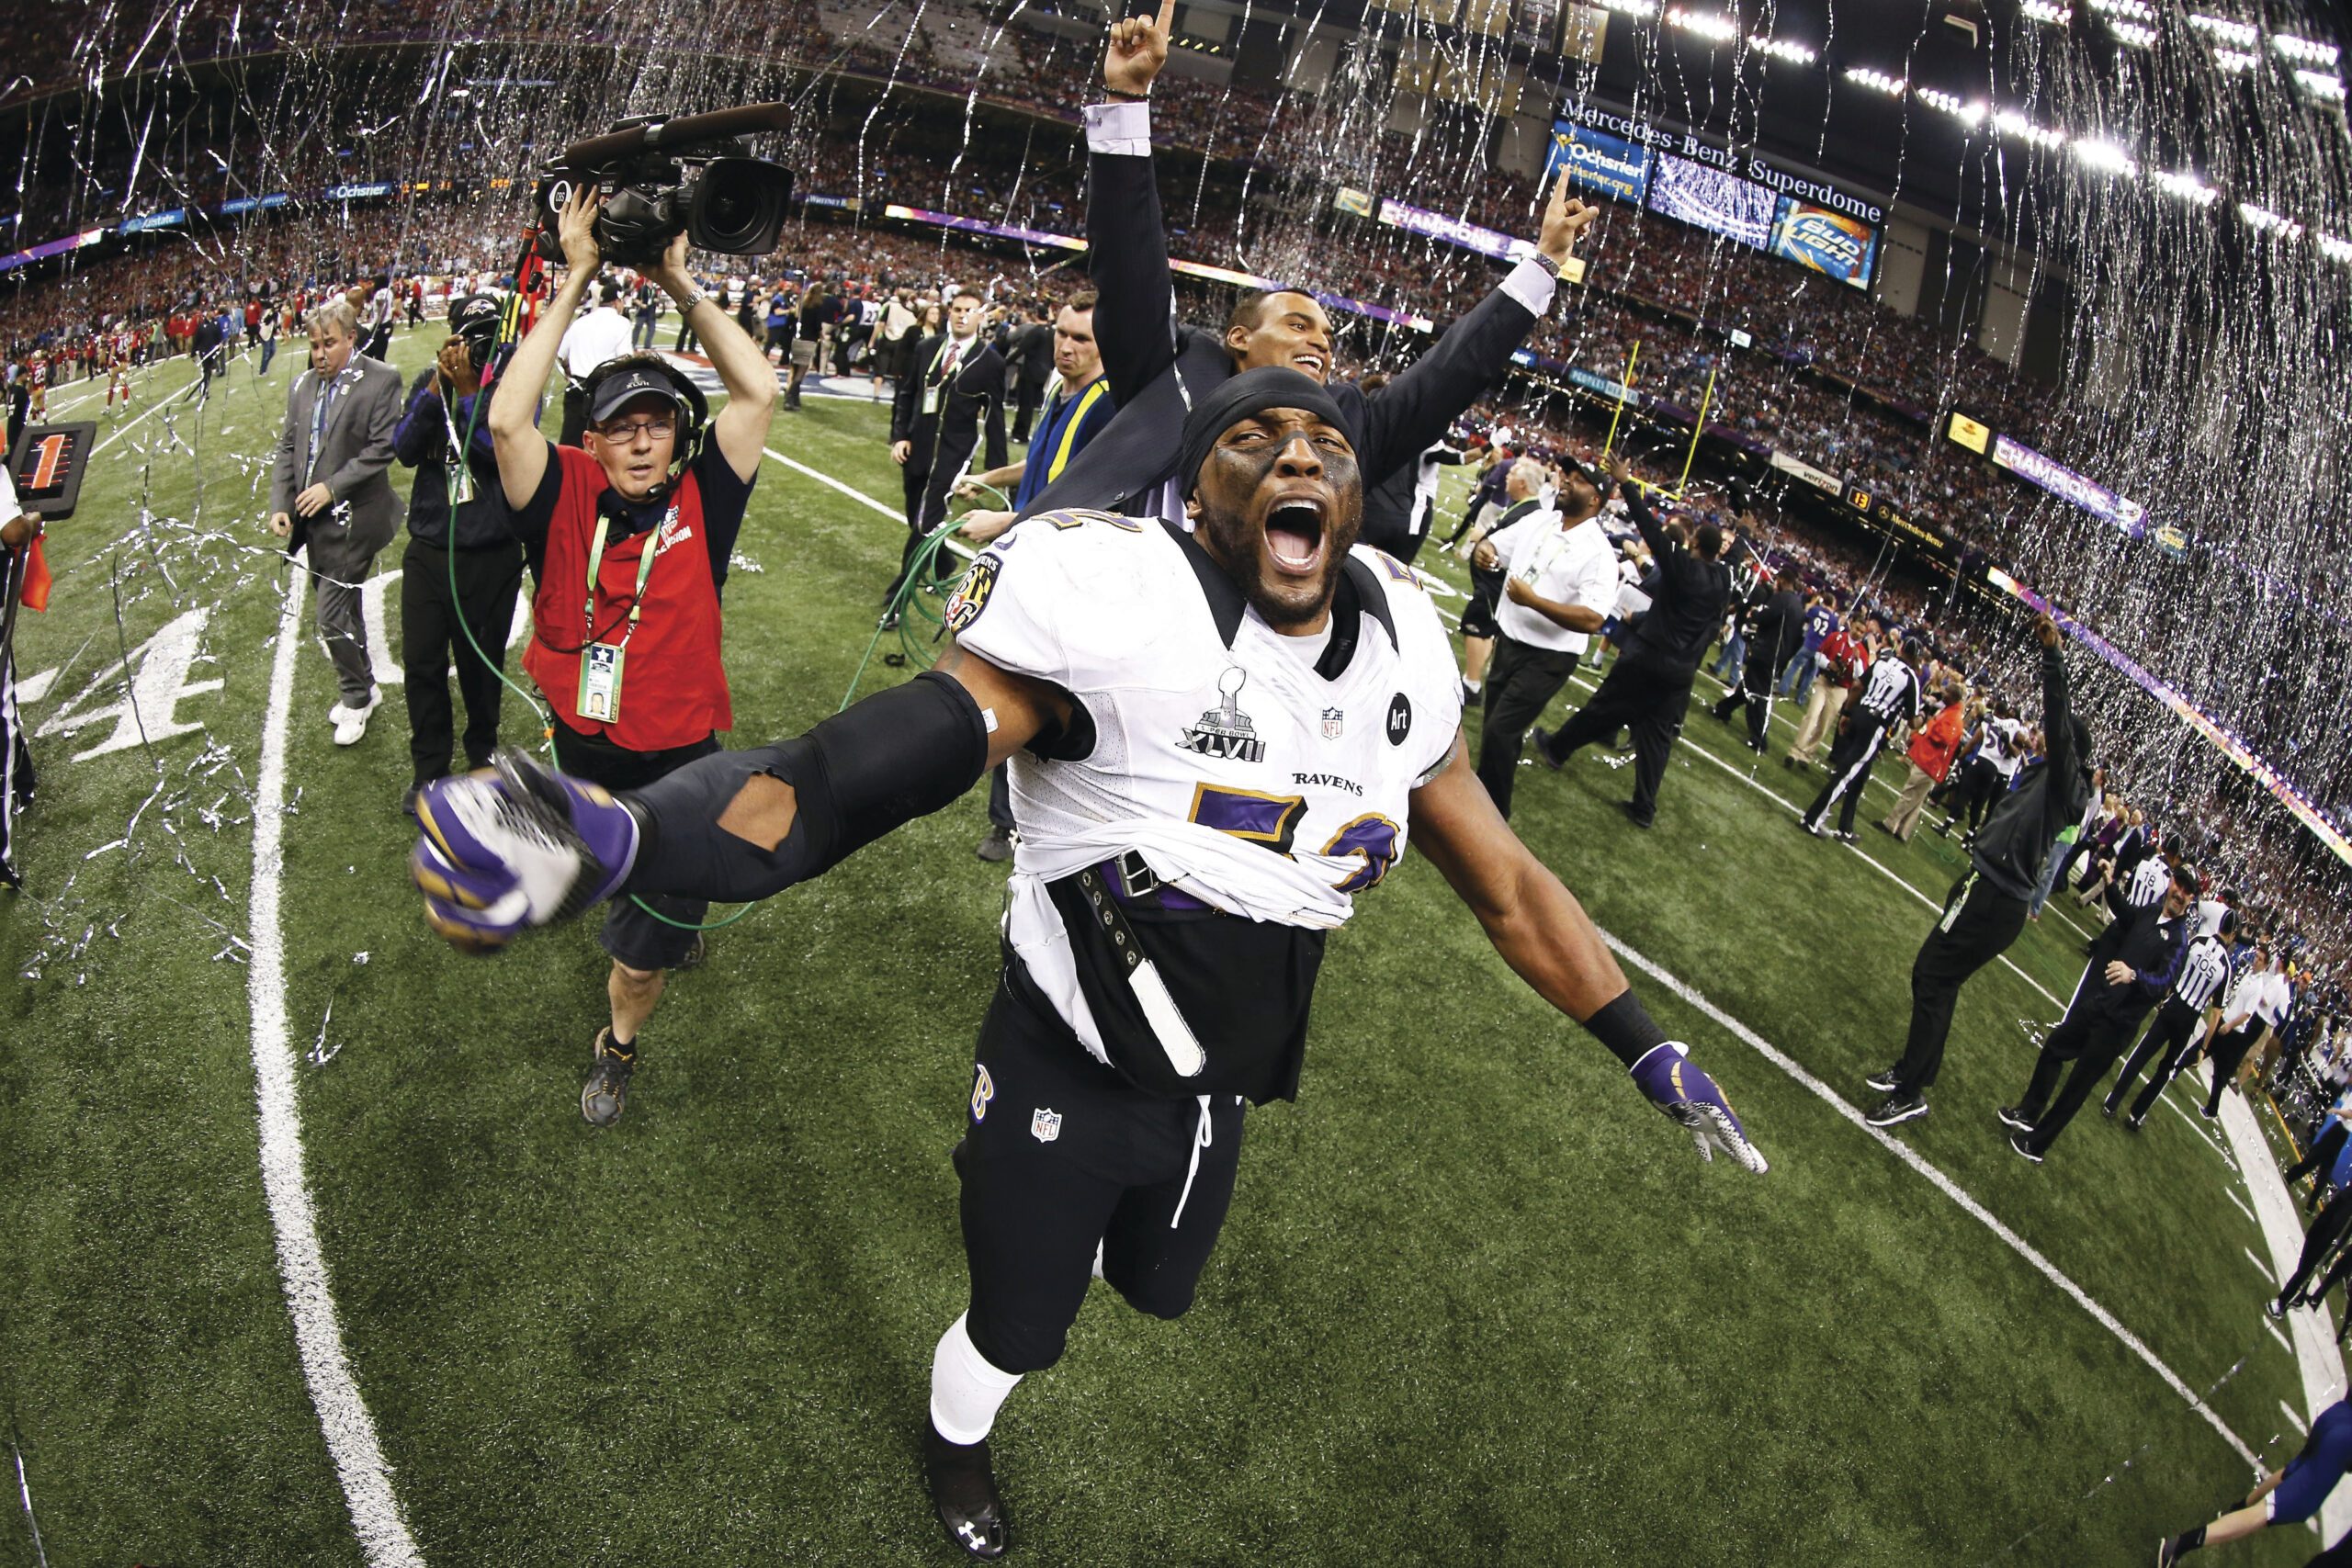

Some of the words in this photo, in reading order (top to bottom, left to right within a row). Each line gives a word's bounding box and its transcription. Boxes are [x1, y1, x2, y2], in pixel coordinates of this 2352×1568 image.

[1560, 97, 1739, 171] Mercedes-Benz
[1750, 159, 1882, 222] Superdome
[1570, 143, 1645, 177] Ochsner
[336, 185, 386, 199] Ochsner
[1557, 163, 1634, 196] ohsner.org
[555, 191, 565, 202] CBS
[1381, 202, 1501, 249] CHAMPIONS
[1801, 219, 1860, 255] BUD
[1789, 226, 1859, 265] LIGHT
[31, 434, 65, 489] 1
[1804, 469, 1838, 492] verizon
[1996, 440, 2109, 512] CHAMPIONS
[1854, 491, 1869, 509] 13
[1891, 513, 1944, 549] Mercedes-Benz
[1813, 616, 1829, 637] 92
[1323, 720, 1342, 737] NFL
[1391, 708, 1408, 731] Art
[1174, 727, 1266, 763] XLVII
[1228, 729, 1250, 738] BOWL
[1291, 773, 1363, 797] RAVENS
[2143, 871, 2156, 887] 18
[2196, 953, 2217, 980] 105
[1035, 1122, 1055, 1137] NFL
